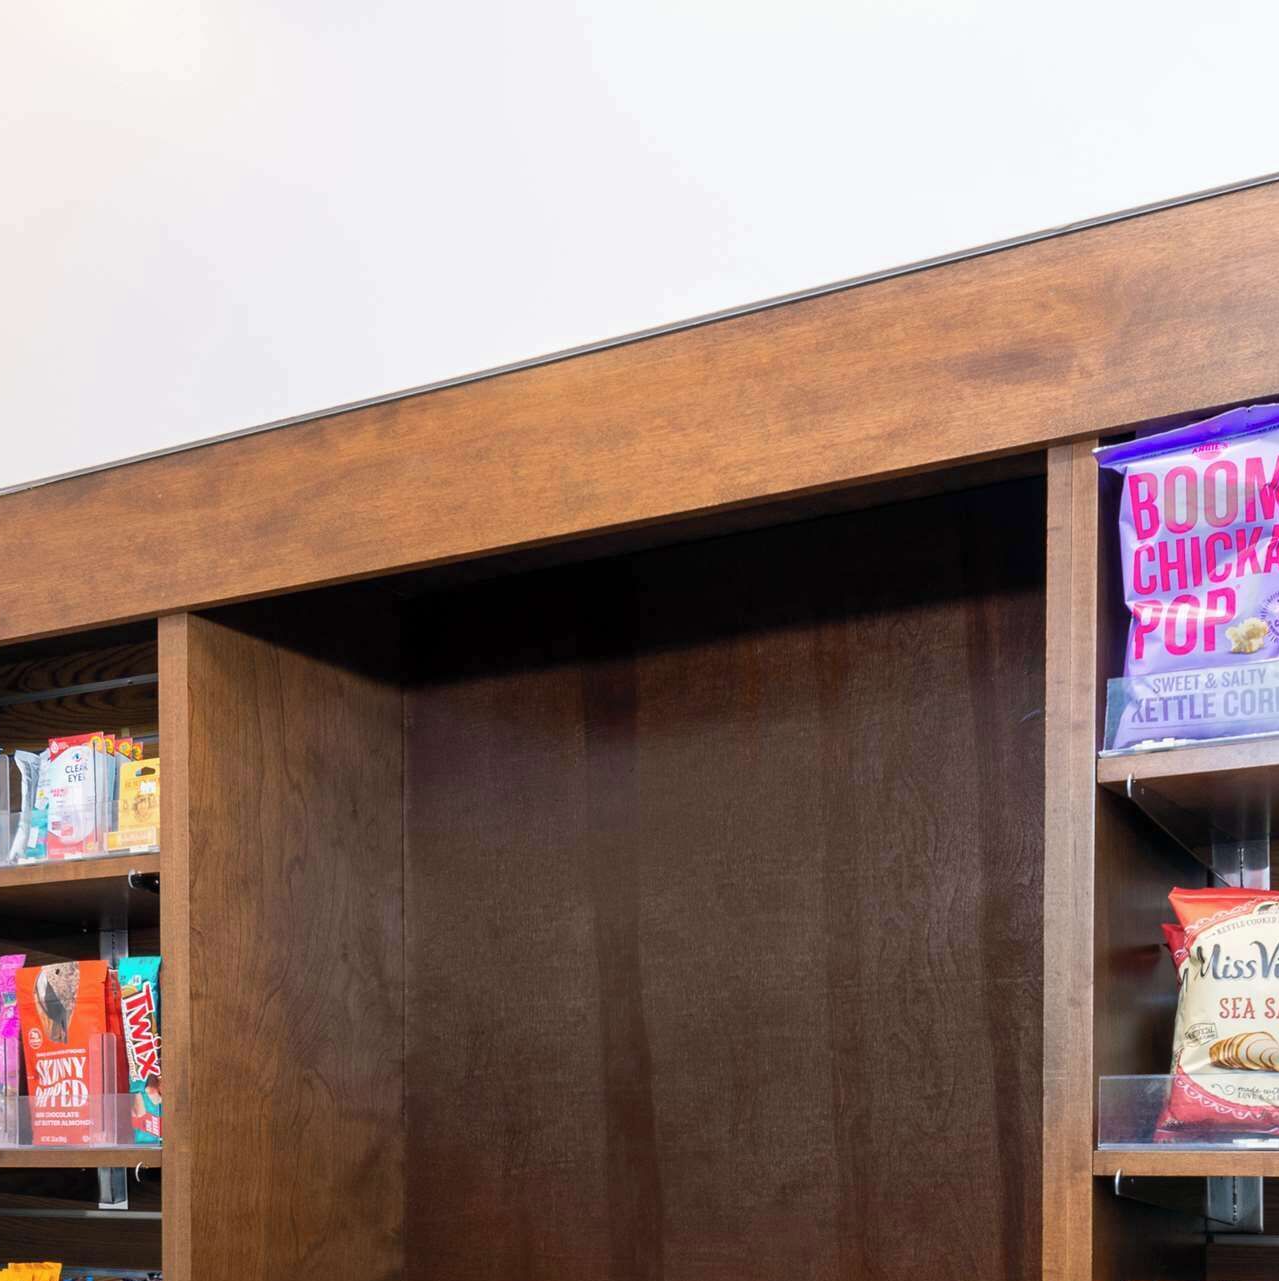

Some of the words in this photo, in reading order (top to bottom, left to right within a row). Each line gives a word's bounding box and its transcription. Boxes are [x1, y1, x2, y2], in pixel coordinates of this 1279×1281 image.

[1133, 587, 1236, 661] POP
[1153, 671, 1203, 694] SWEET
[1205, 673, 1218, 690] &
[1221, 668, 1266, 689] SALTY
[1131, 691, 1216, 724] KETTLE
[1218, 996, 1256, 1020] SEA
[37, 1056, 86, 1087] SKINNY
